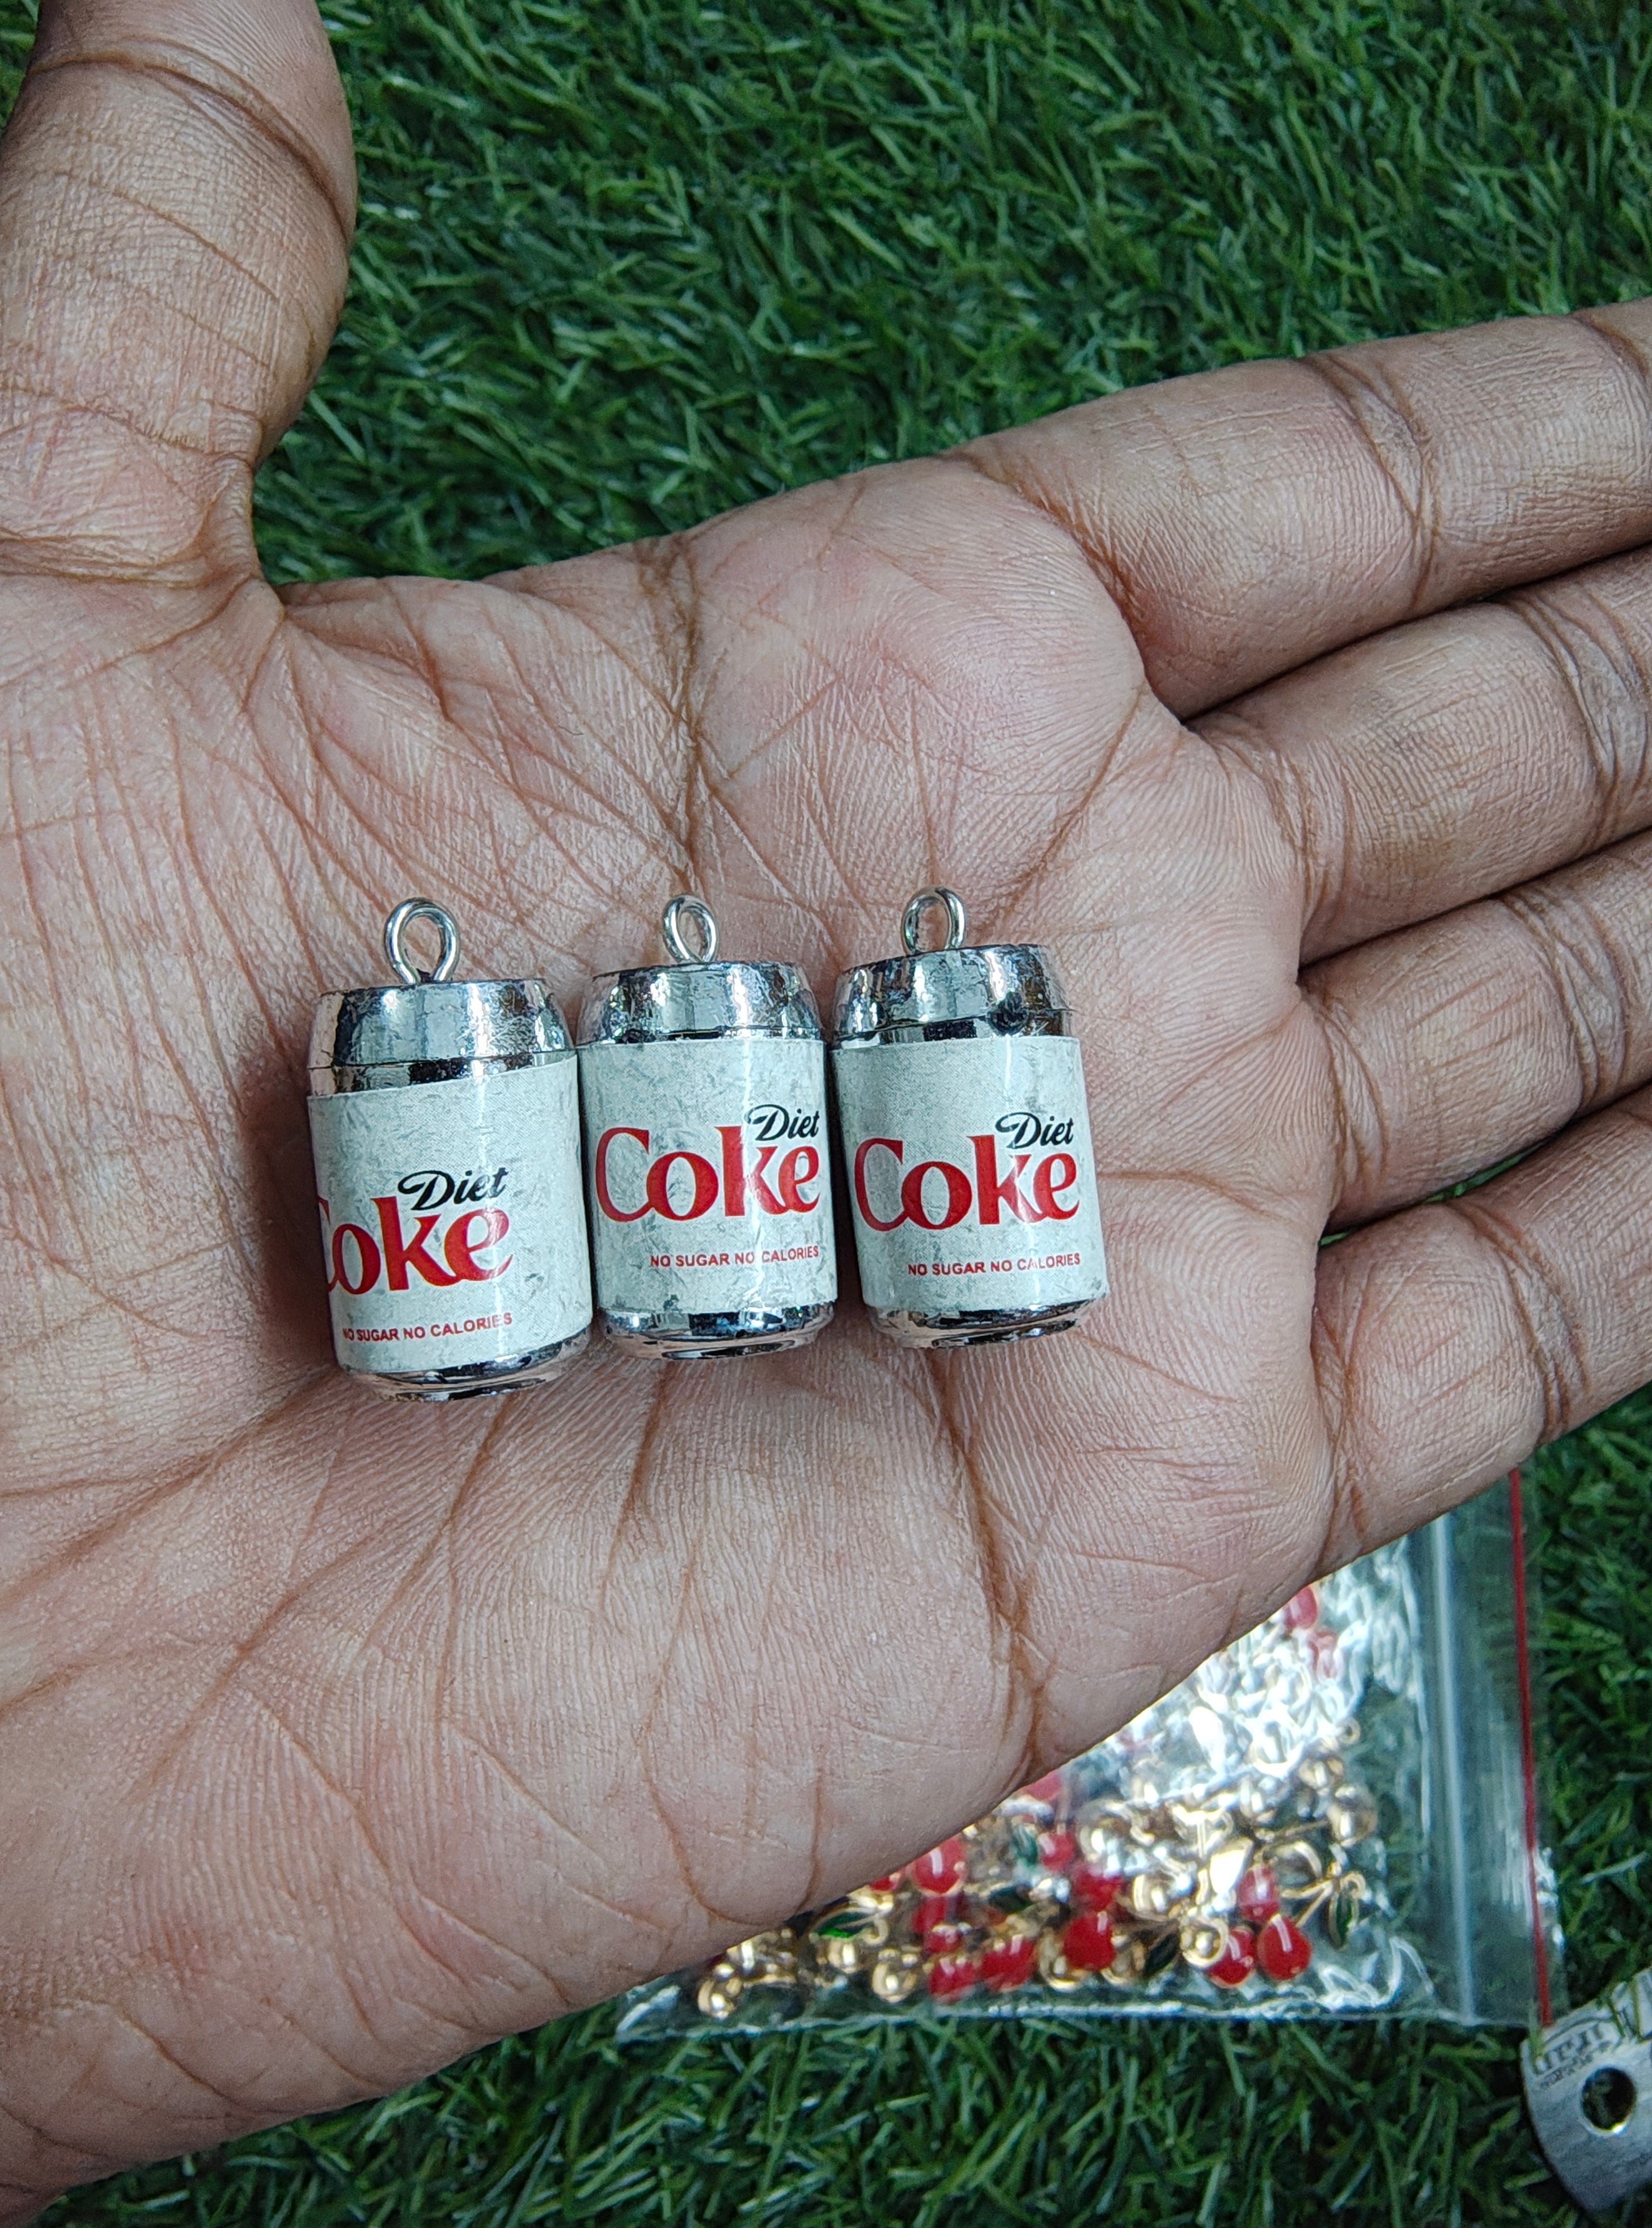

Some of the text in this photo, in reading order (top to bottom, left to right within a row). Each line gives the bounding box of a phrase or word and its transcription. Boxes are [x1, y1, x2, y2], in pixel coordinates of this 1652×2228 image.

[744, 1104, 820, 1141] Diet
[995, 1112, 1074, 1149] Diet
[397, 1167, 509, 1210] Diet
[595, 1125, 821, 1223] Coke
[854, 1134, 1080, 1232] Coke
[650, 1245, 819, 1267] NO SUGAR NO CALORIES
[908, 1253, 1081, 1277] NO SUGAR NO CALORIES
[357, 1328, 400, 1342] SUGAR
[403, 1326, 426, 1340] NO
[430, 1312, 513, 1338] CALORIES
